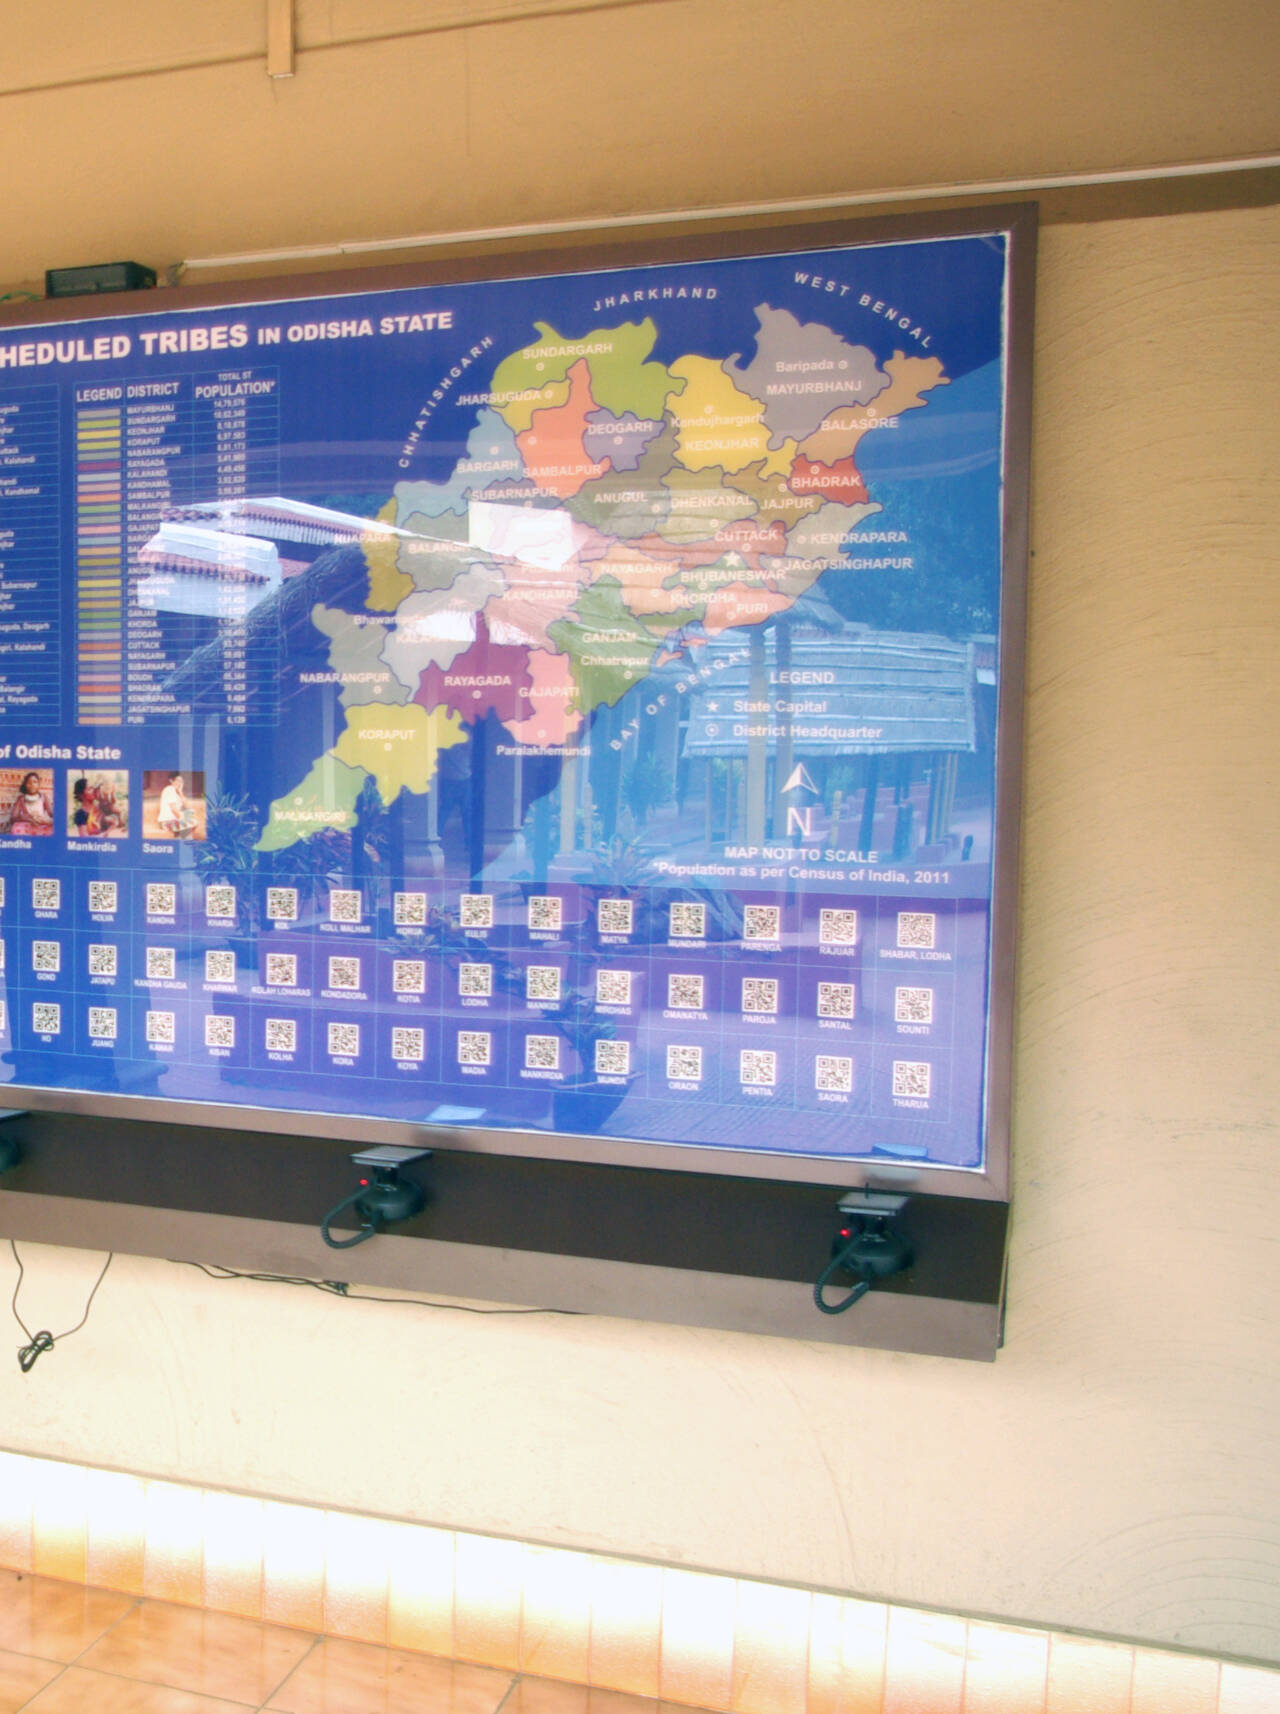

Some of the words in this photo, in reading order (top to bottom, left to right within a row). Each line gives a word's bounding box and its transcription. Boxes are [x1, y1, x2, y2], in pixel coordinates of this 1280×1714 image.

[593, 286, 717, 312] JHARKHAND
[793, 271, 851, 297] WEST
[858, 294, 935, 349] BENGAL
[139, 324, 248, 356] TRIBES
[258, 327, 280, 346] IN
[287, 320, 373, 342] ODISHA
[380, 311, 453, 335] STATE
[522, 342, 613, 360] SUNDARGARH
[775, 359, 834, 376] Baripada
[218, 372, 241, 382] TOTAL
[76, 387, 122, 402] LEGEND
[127, 382, 180, 399] DISTRICT
[766, 380, 862, 396] MAYURBHANJ
[399, 335, 494, 469] CHHATISHGARH
[455, 390, 542, 407] JHARSUGUDA
[587, 421, 653, 435] DEOGARH
[821, 417, 899, 432] BALASORE
[685, 438, 759, 452] KEONJHAR
[456, 460, 519, 473] BARGARH
[522, 464, 602, 478] SAMBALPUR
[791, 476, 861, 489] BHADRAK
[471, 487, 558, 502] SUBARNAPUR
[594, 491, 648, 504] ANUGUL
[671, 495, 753, 509] DHENKANAL
[760, 497, 814, 511] JAJPUR
[714, 529, 778, 542] CUTTACK
[810, 531, 908, 545] KENDRAPARA
[784, 557, 913, 571] JAGATSINGHAPUR
[680, 569, 787, 583] BHUBANESWAR
[736, 602, 768, 615] PURI
[581, 655, 649, 668] Chhatrapur
[300, 672, 390, 684] NABARANGPUR
[444, 676, 512, 687] RAYAGADA
[770, 671, 835, 684] LEGEND
[519, 686, 580, 698] GAJAPATI
[610, 716, 640, 751] BAY
[645, 694, 666, 716] OF
[675, 646, 751, 694] BENGAL
[733, 700, 771, 713] State
[775, 701, 827, 715] Capital
[358, 729, 416, 740] KORAPUT
[733, 724, 786, 738] District
[790, 725, 882, 741] Headquarter
[15, 746, 73, 760] Odisha
[75, 746, 121, 761] State
[496, 745, 591, 757] Paralakhemundi
[786, 806, 811, 836] N
[67, 840, 117, 852] Mankirdia
[142, 842, 173, 854] Saora
[724, 846, 758, 859] MAP
[762, 847, 795, 861] NOT
[799, 848, 820, 862] TO
[824, 849, 878, 864] SCALE
[739, 867, 756, 877] as
[761, 866, 785, 882] per
[788, 866, 847, 881] Census
[850, 867, 865, 881] of
[868, 869, 909, 885] India,
[914, 870, 950, 884] 2011
[920, 951, 952, 961] LODHA
[461, 998, 489, 1007] LODHA
[742, 1014, 776, 1025] PAROJA
[819, 1020, 852, 1031] SANTAL
[896, 1024, 930, 1035] SOUNTI
[818, 1092, 848, 1103] SAORA
[892, 1097, 929, 1109] THARUA
